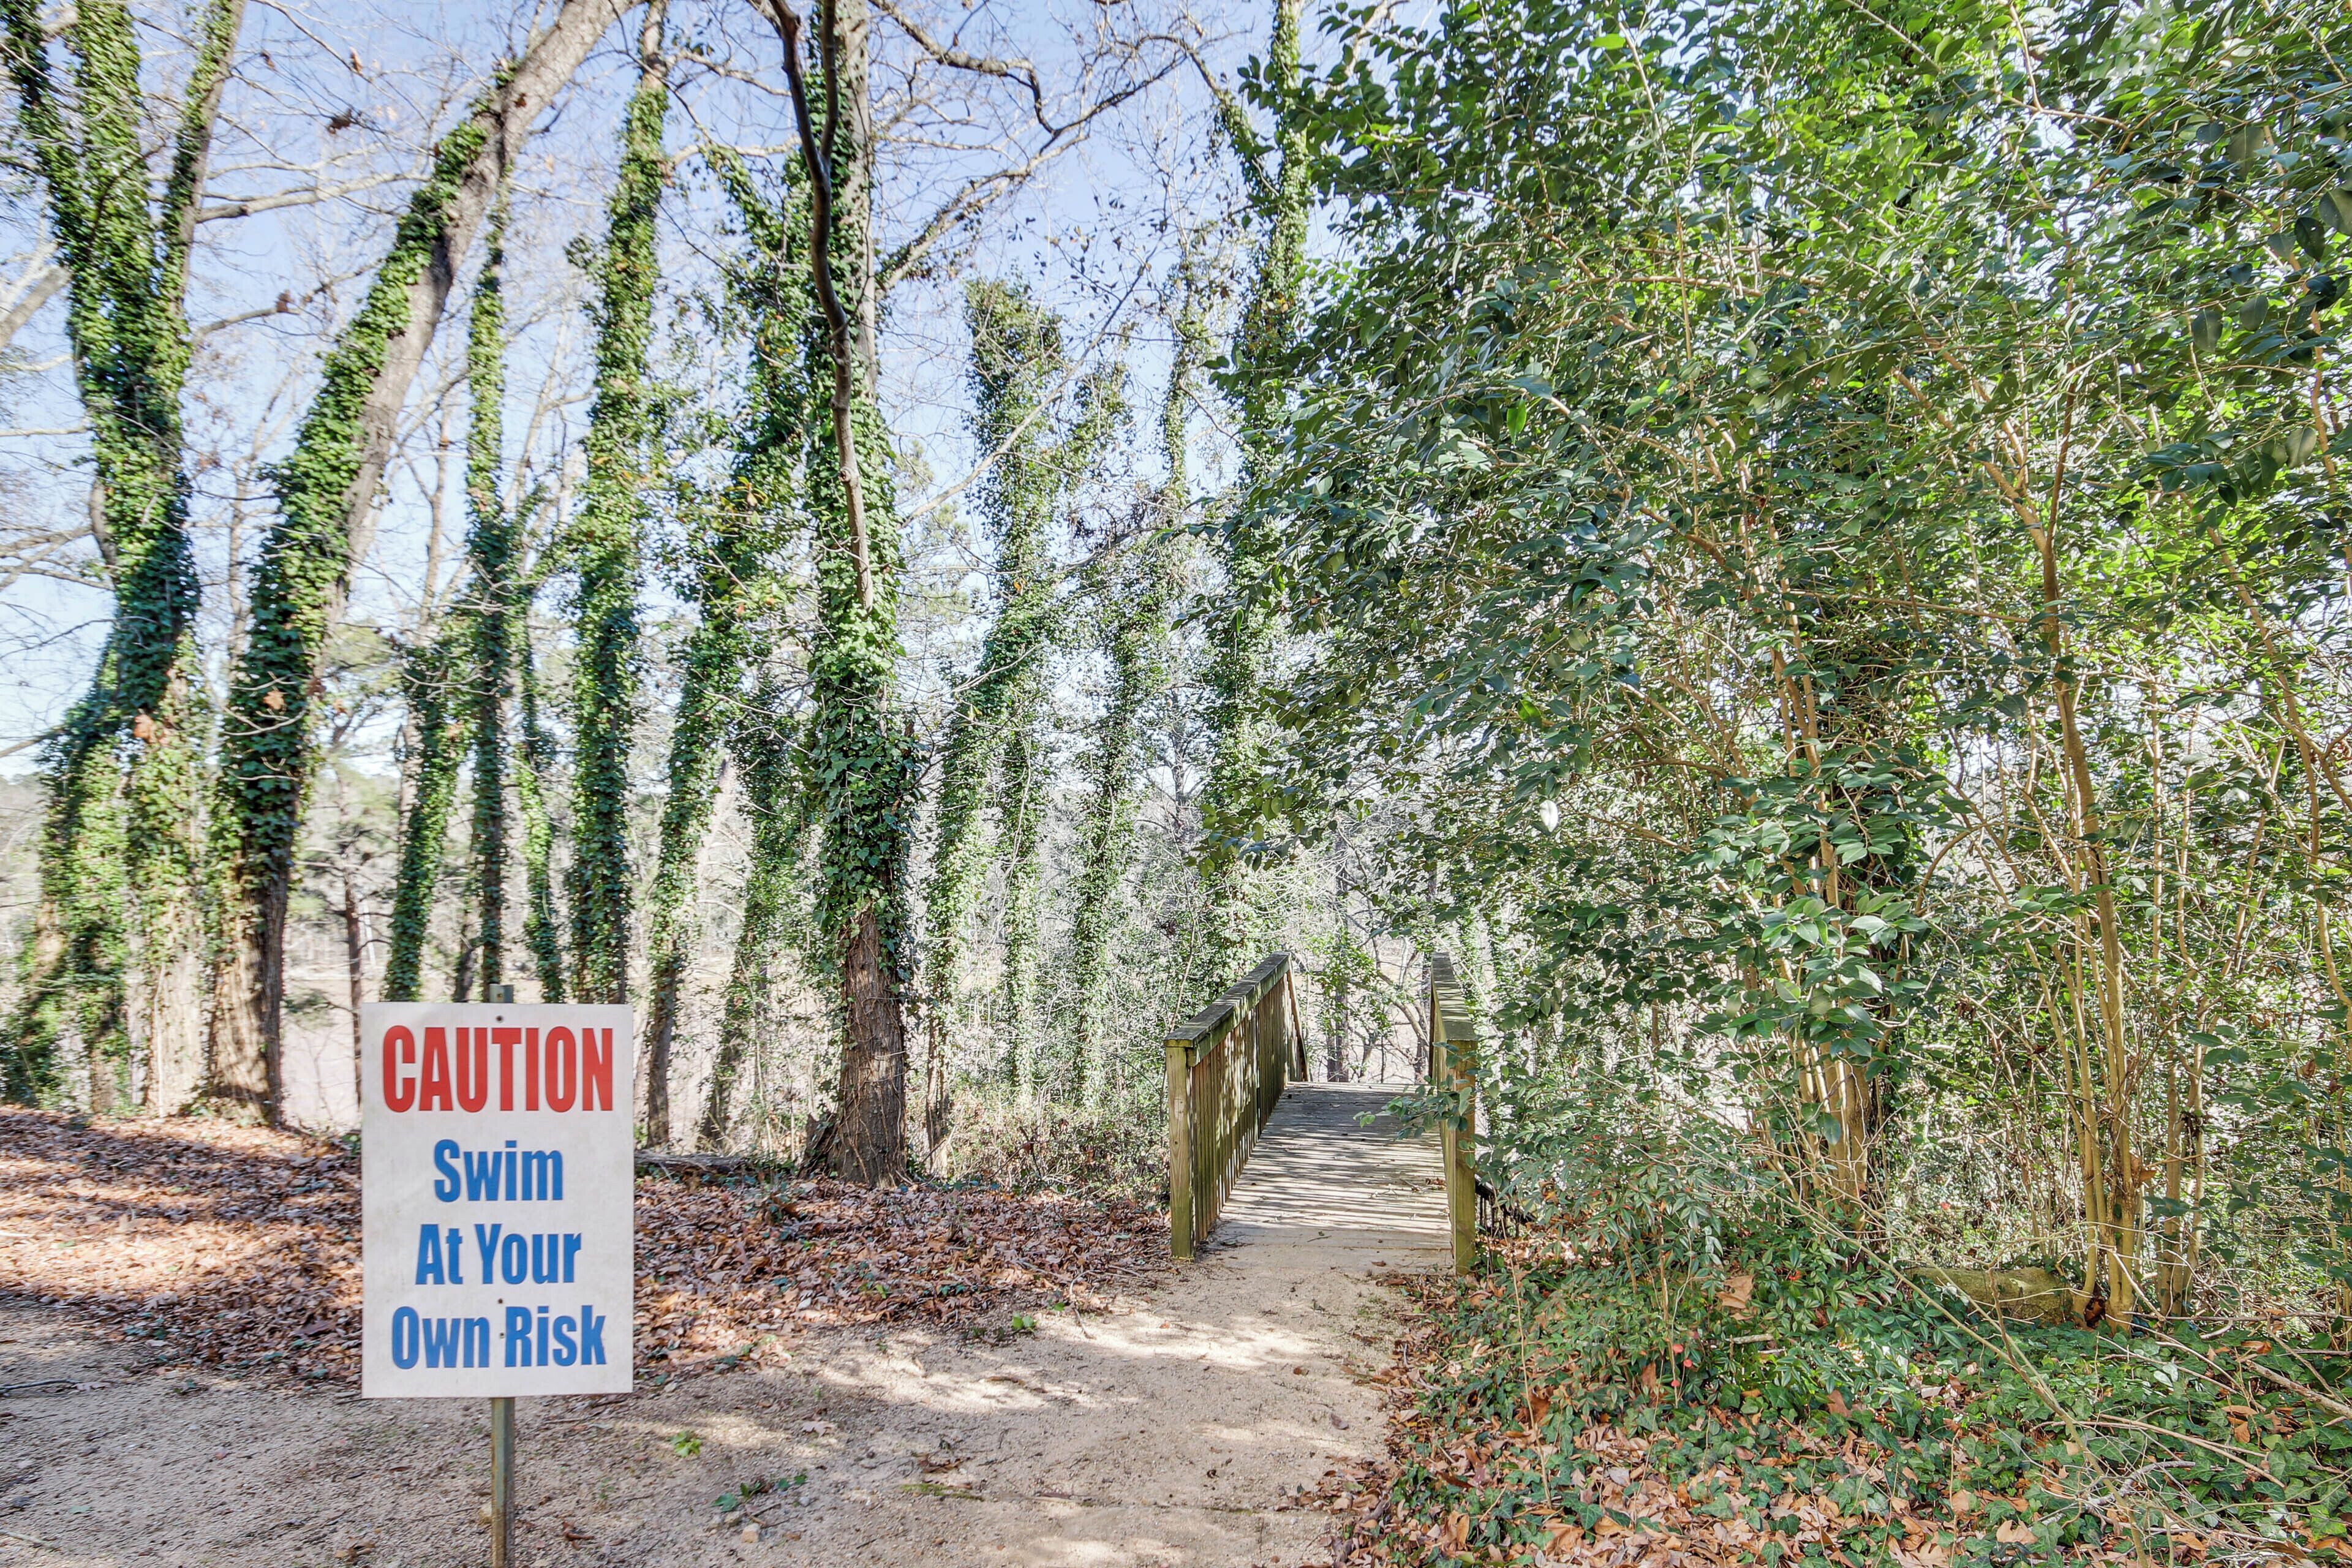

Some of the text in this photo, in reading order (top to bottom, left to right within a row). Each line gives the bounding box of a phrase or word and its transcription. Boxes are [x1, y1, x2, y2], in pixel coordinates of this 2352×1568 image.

[383, 1025, 613, 1113] CAUTION
[434, 1139, 563, 1202] Swim
[416, 1224, 581, 1284] At Your
[392, 1305, 606, 1369] Own Risk
